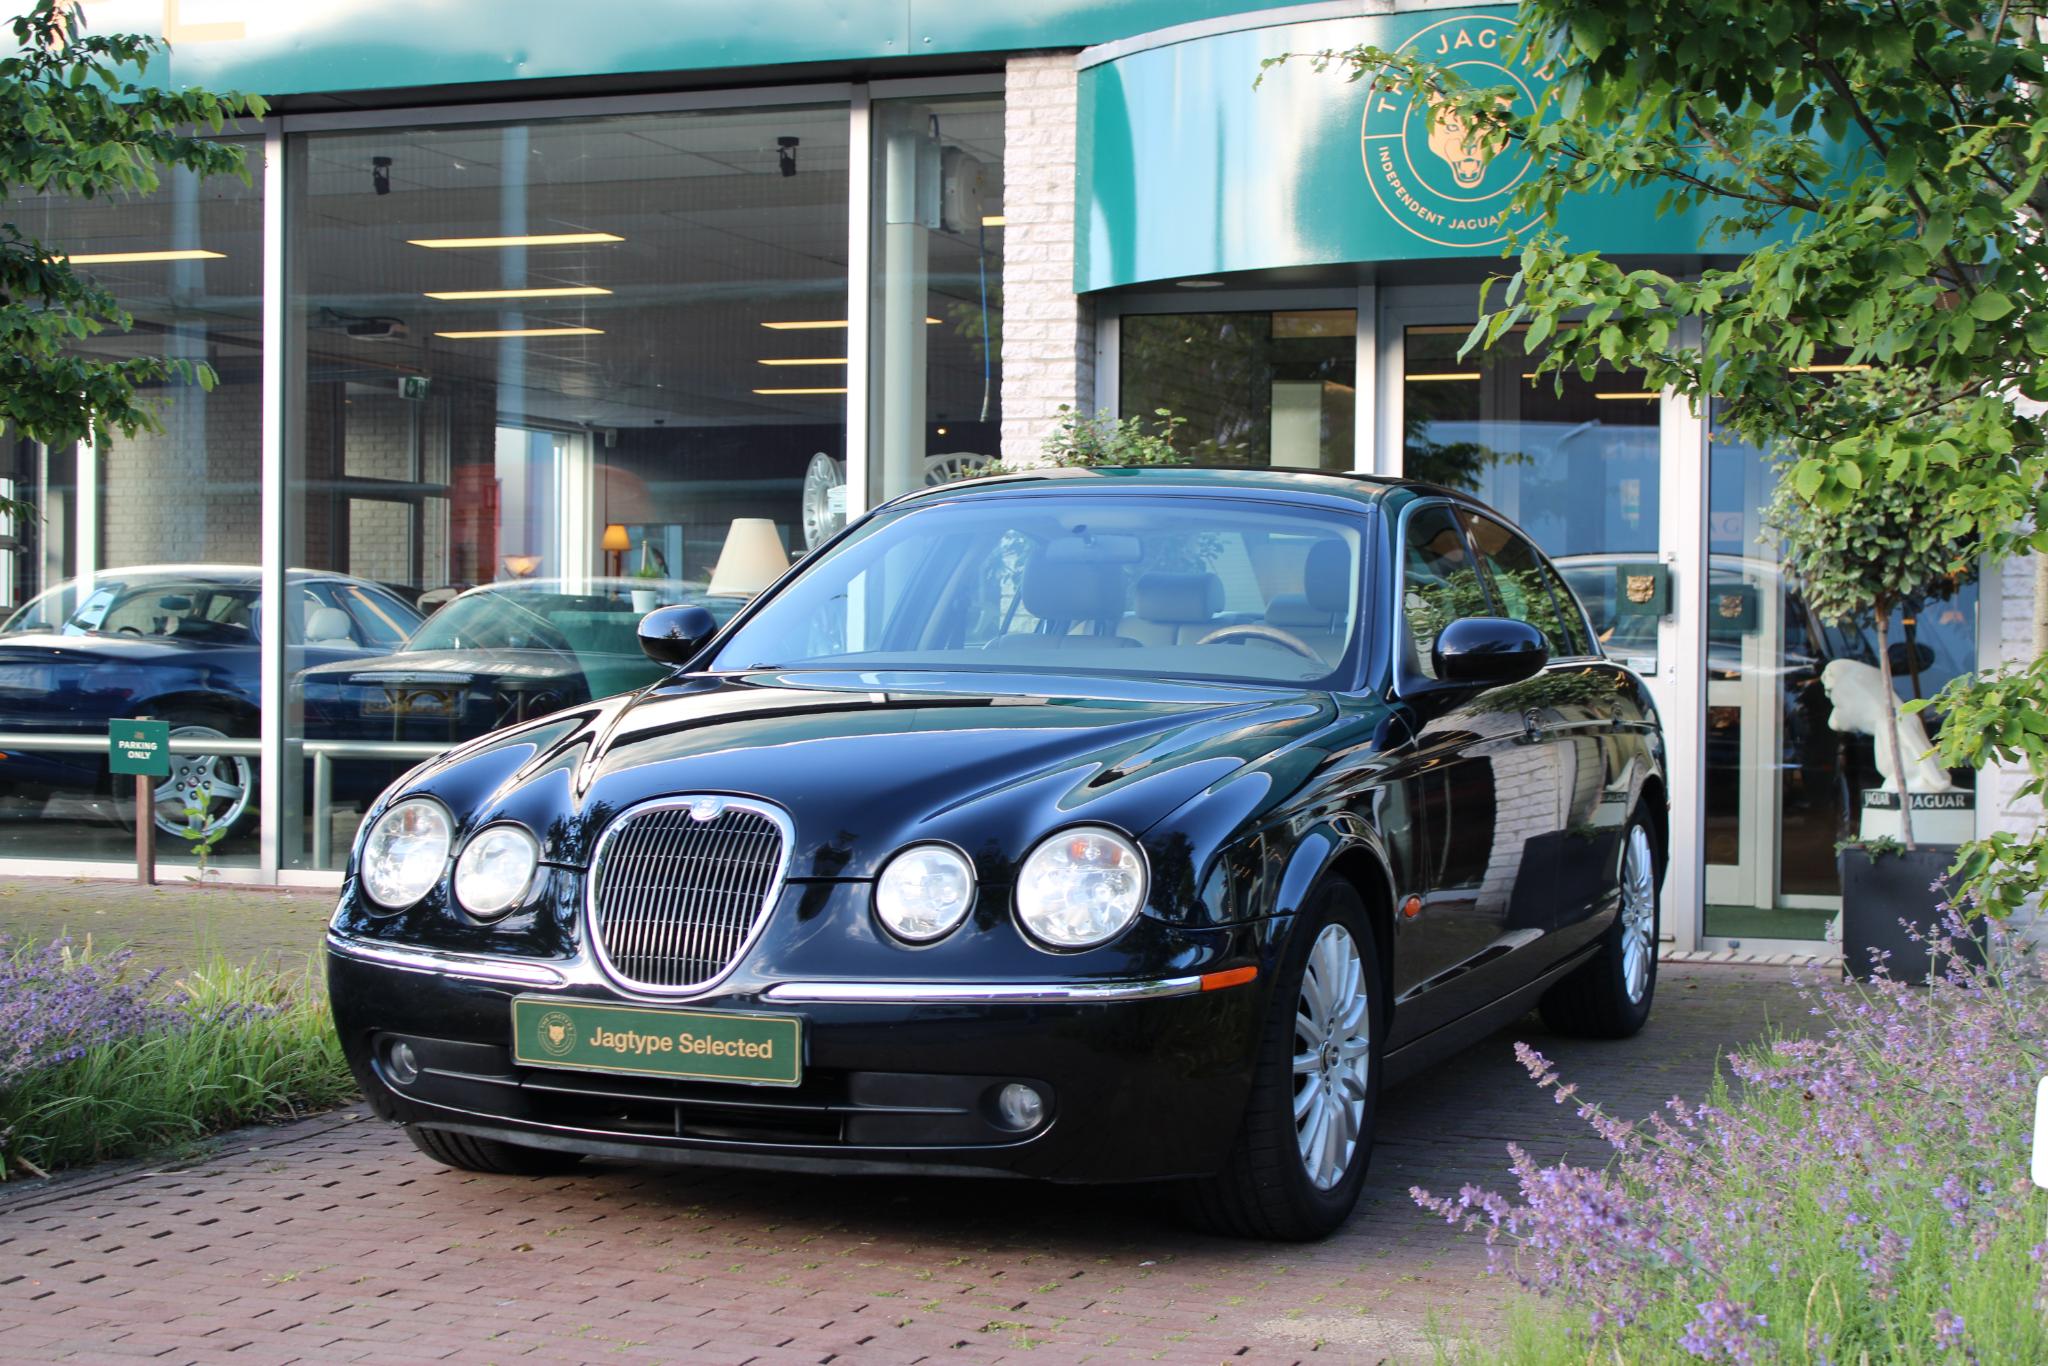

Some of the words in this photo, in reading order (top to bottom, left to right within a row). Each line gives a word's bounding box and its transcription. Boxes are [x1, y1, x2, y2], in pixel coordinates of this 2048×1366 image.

[1378, 145, 1445, 226] INDEPENDENT
[118, 740, 158, 750] PARKING
[127, 750, 151, 759] ONLY
[590, 1027, 673, 1055] Jagtype
[679, 1033, 773, 1059] Selected
